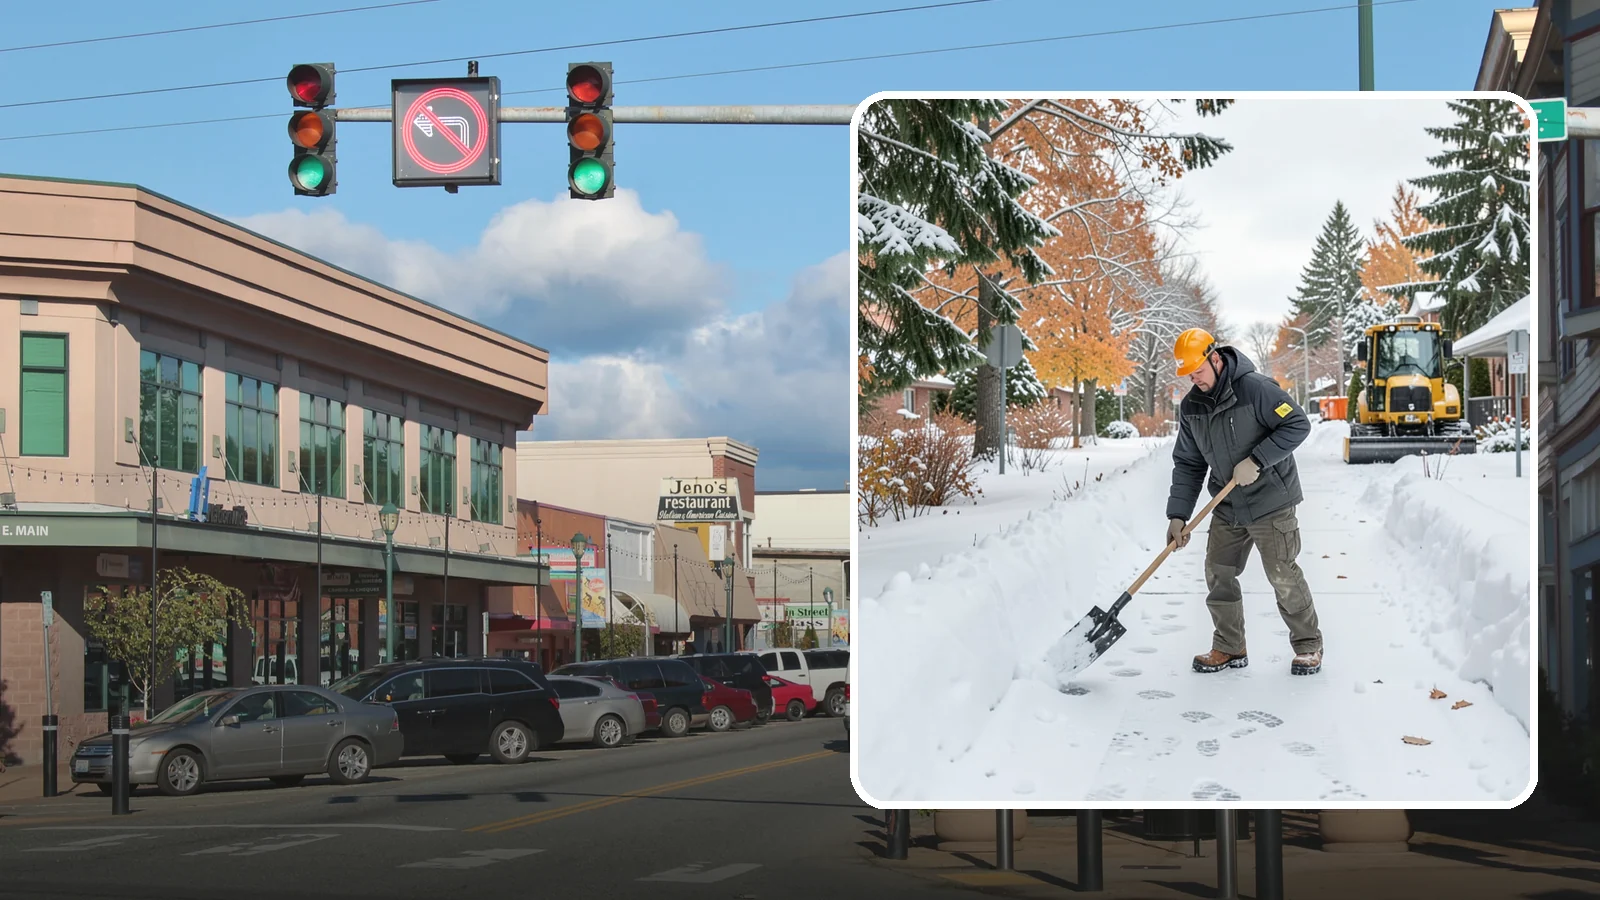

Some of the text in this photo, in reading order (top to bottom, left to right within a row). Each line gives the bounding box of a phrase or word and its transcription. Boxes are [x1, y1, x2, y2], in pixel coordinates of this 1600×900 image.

[669, 480, 728, 494] Jeno's
[665, 496, 731, 509] restaurant
[686, 510, 714, 519] American
[715, 510, 737, 518] Cuisine
[2, 525, 49, 536] E. MAIN
[798, 608, 828, 616] Street
